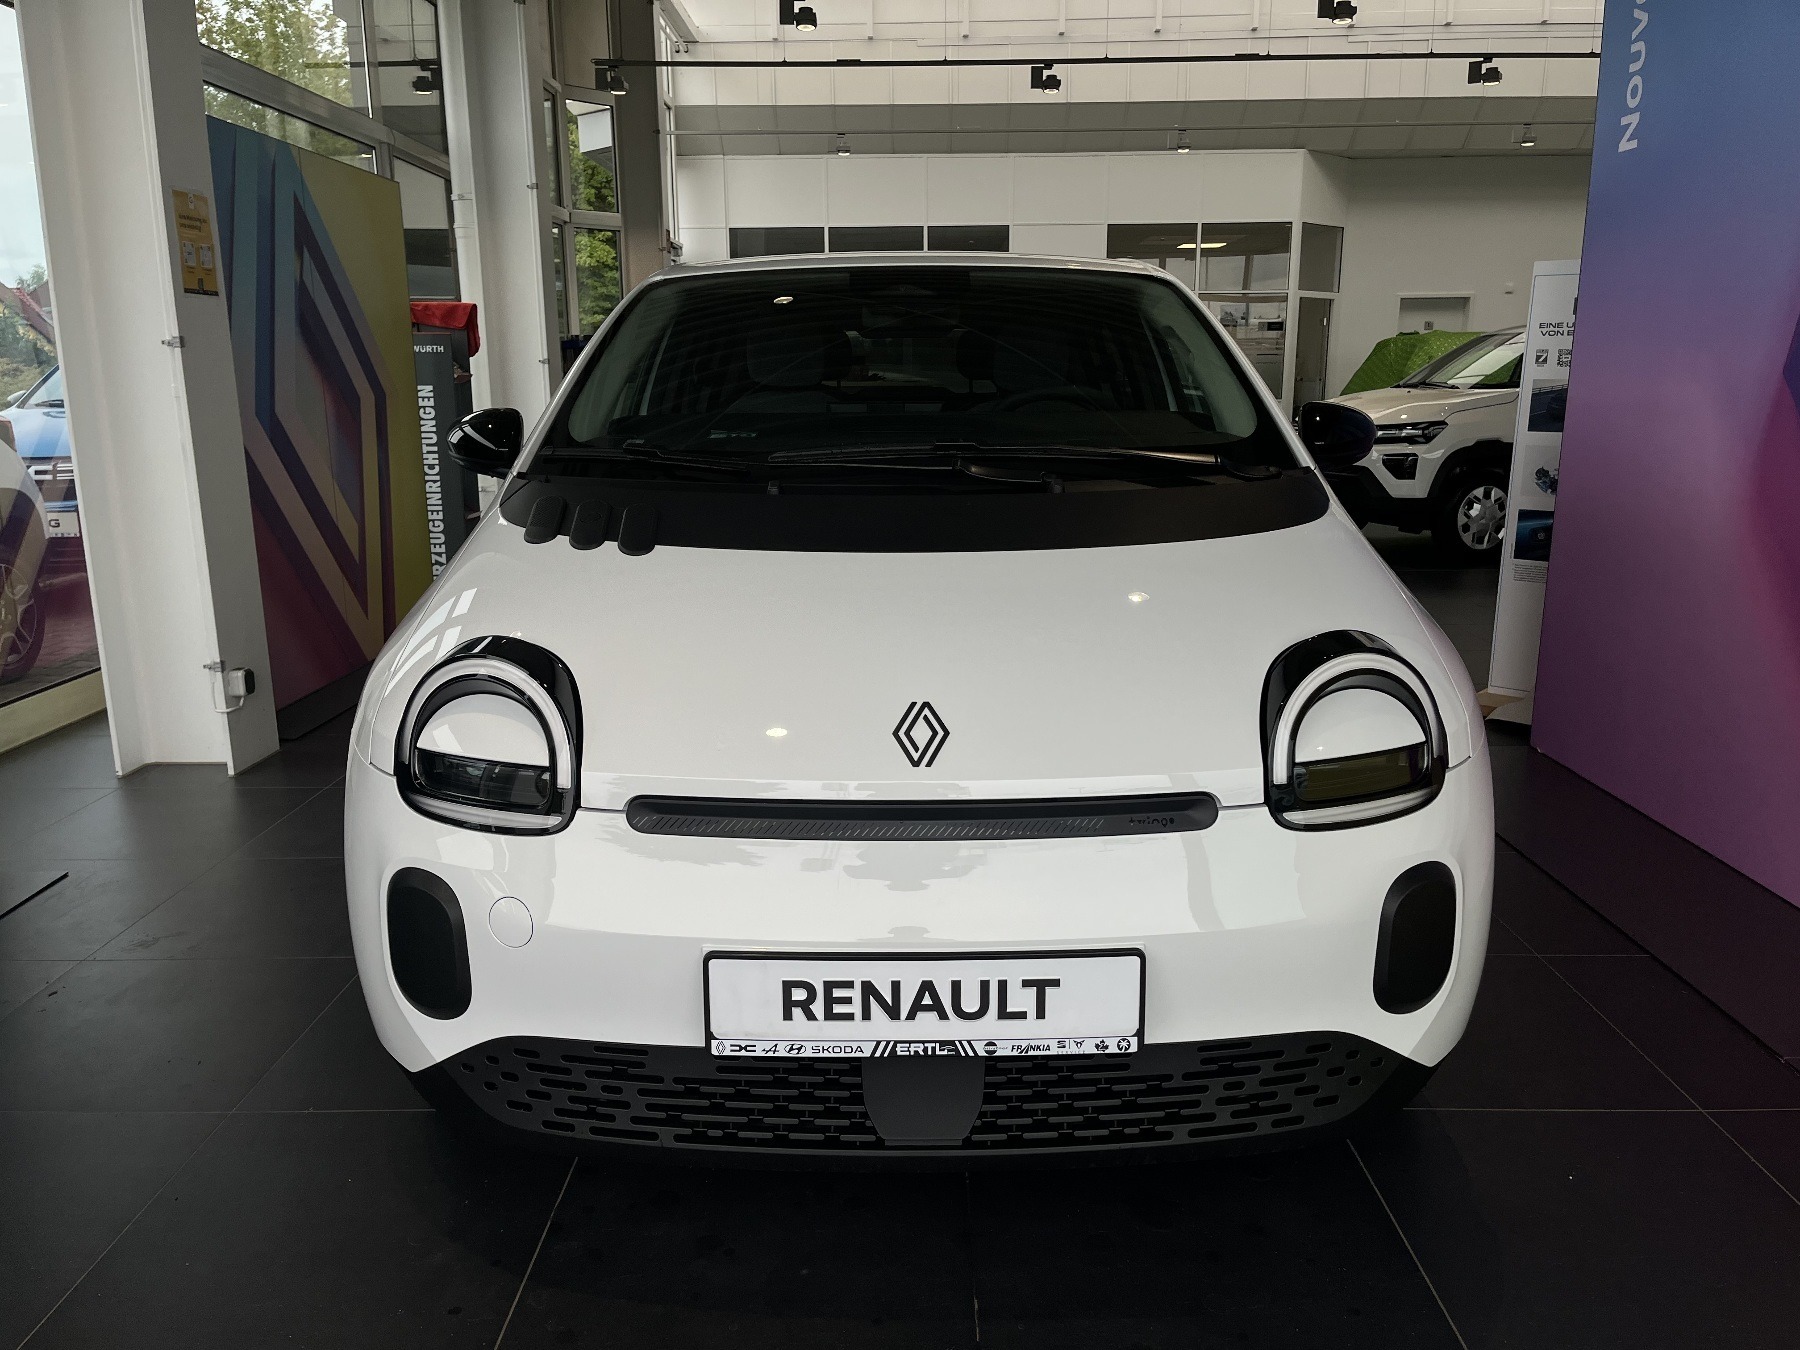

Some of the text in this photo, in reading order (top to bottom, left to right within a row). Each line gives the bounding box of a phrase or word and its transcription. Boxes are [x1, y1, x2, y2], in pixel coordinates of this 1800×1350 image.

[1618, 0, 1649, 152] Nouv
[417, 385, 447, 580] RZEUGEINRICHTUNGEN
[782, 978, 1061, 1021] RENAULT
[896, 1043, 953, 1056] ERTL
[1011, 1043, 1051, 1054] FRANKIA
